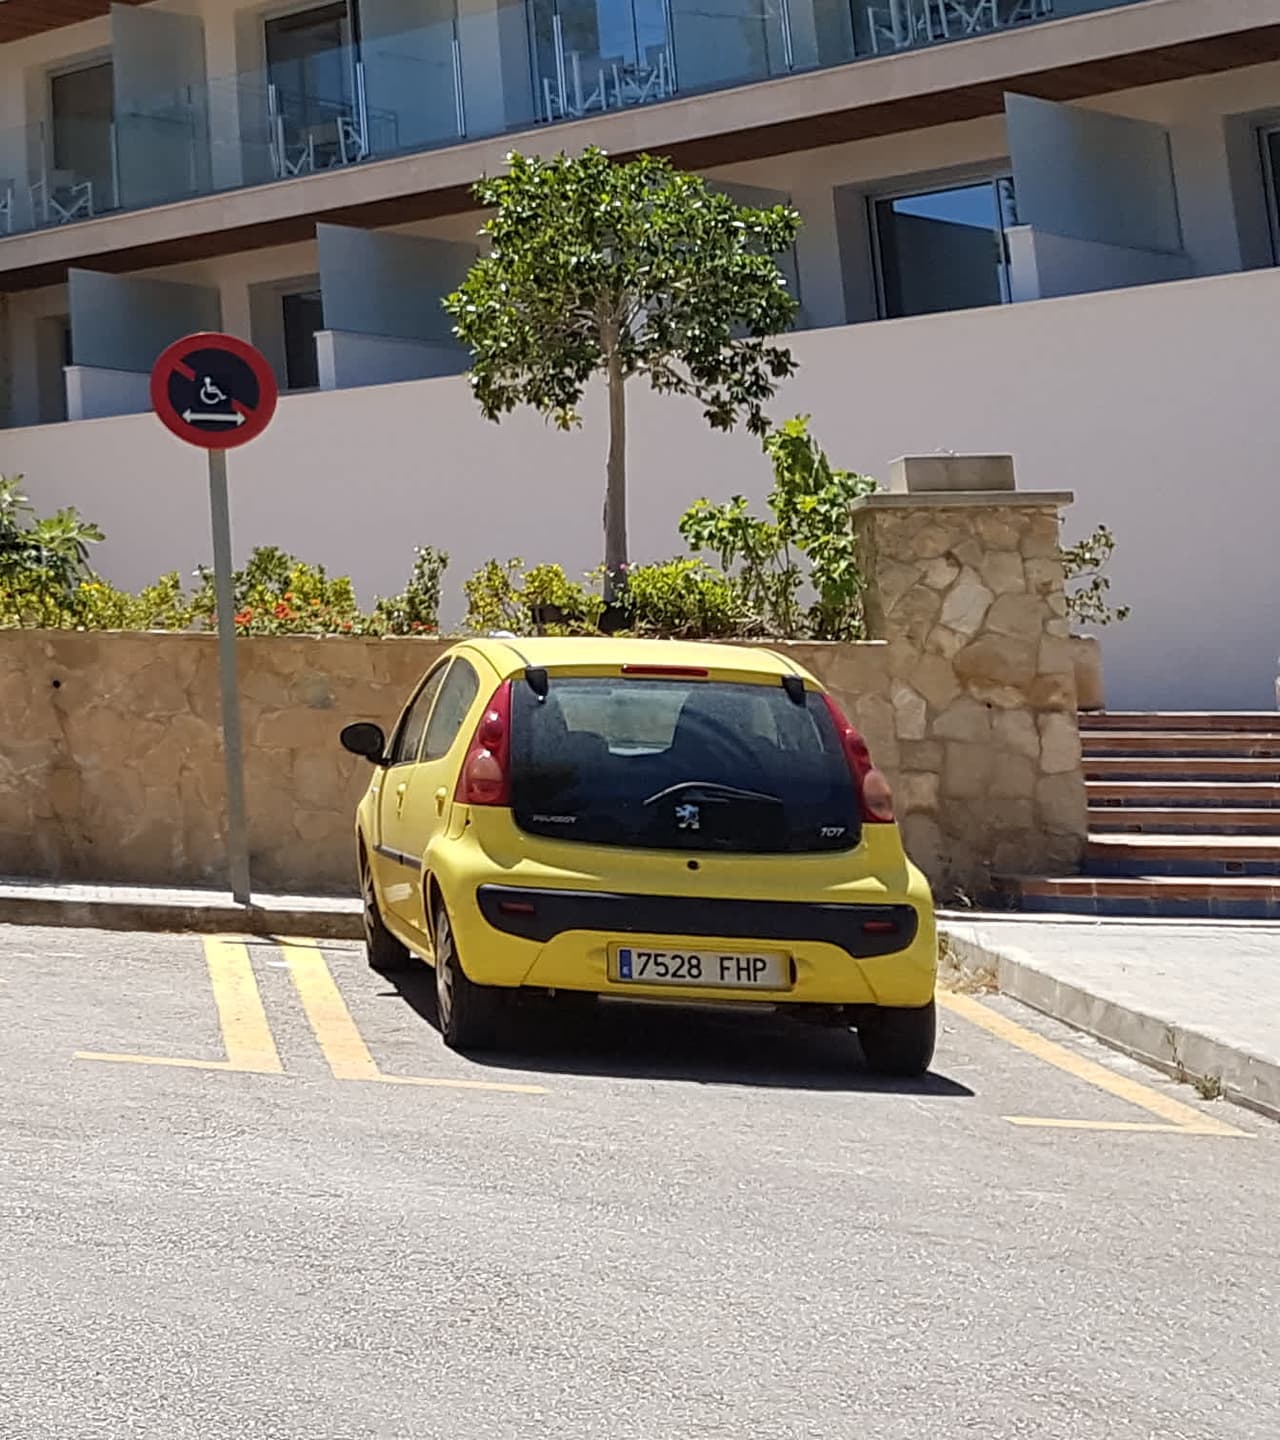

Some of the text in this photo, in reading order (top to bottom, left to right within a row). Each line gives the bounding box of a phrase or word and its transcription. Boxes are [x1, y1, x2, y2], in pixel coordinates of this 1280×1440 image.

[820, 827, 845, 837] 107
[636, 952, 767, 982] 7528 FHP
